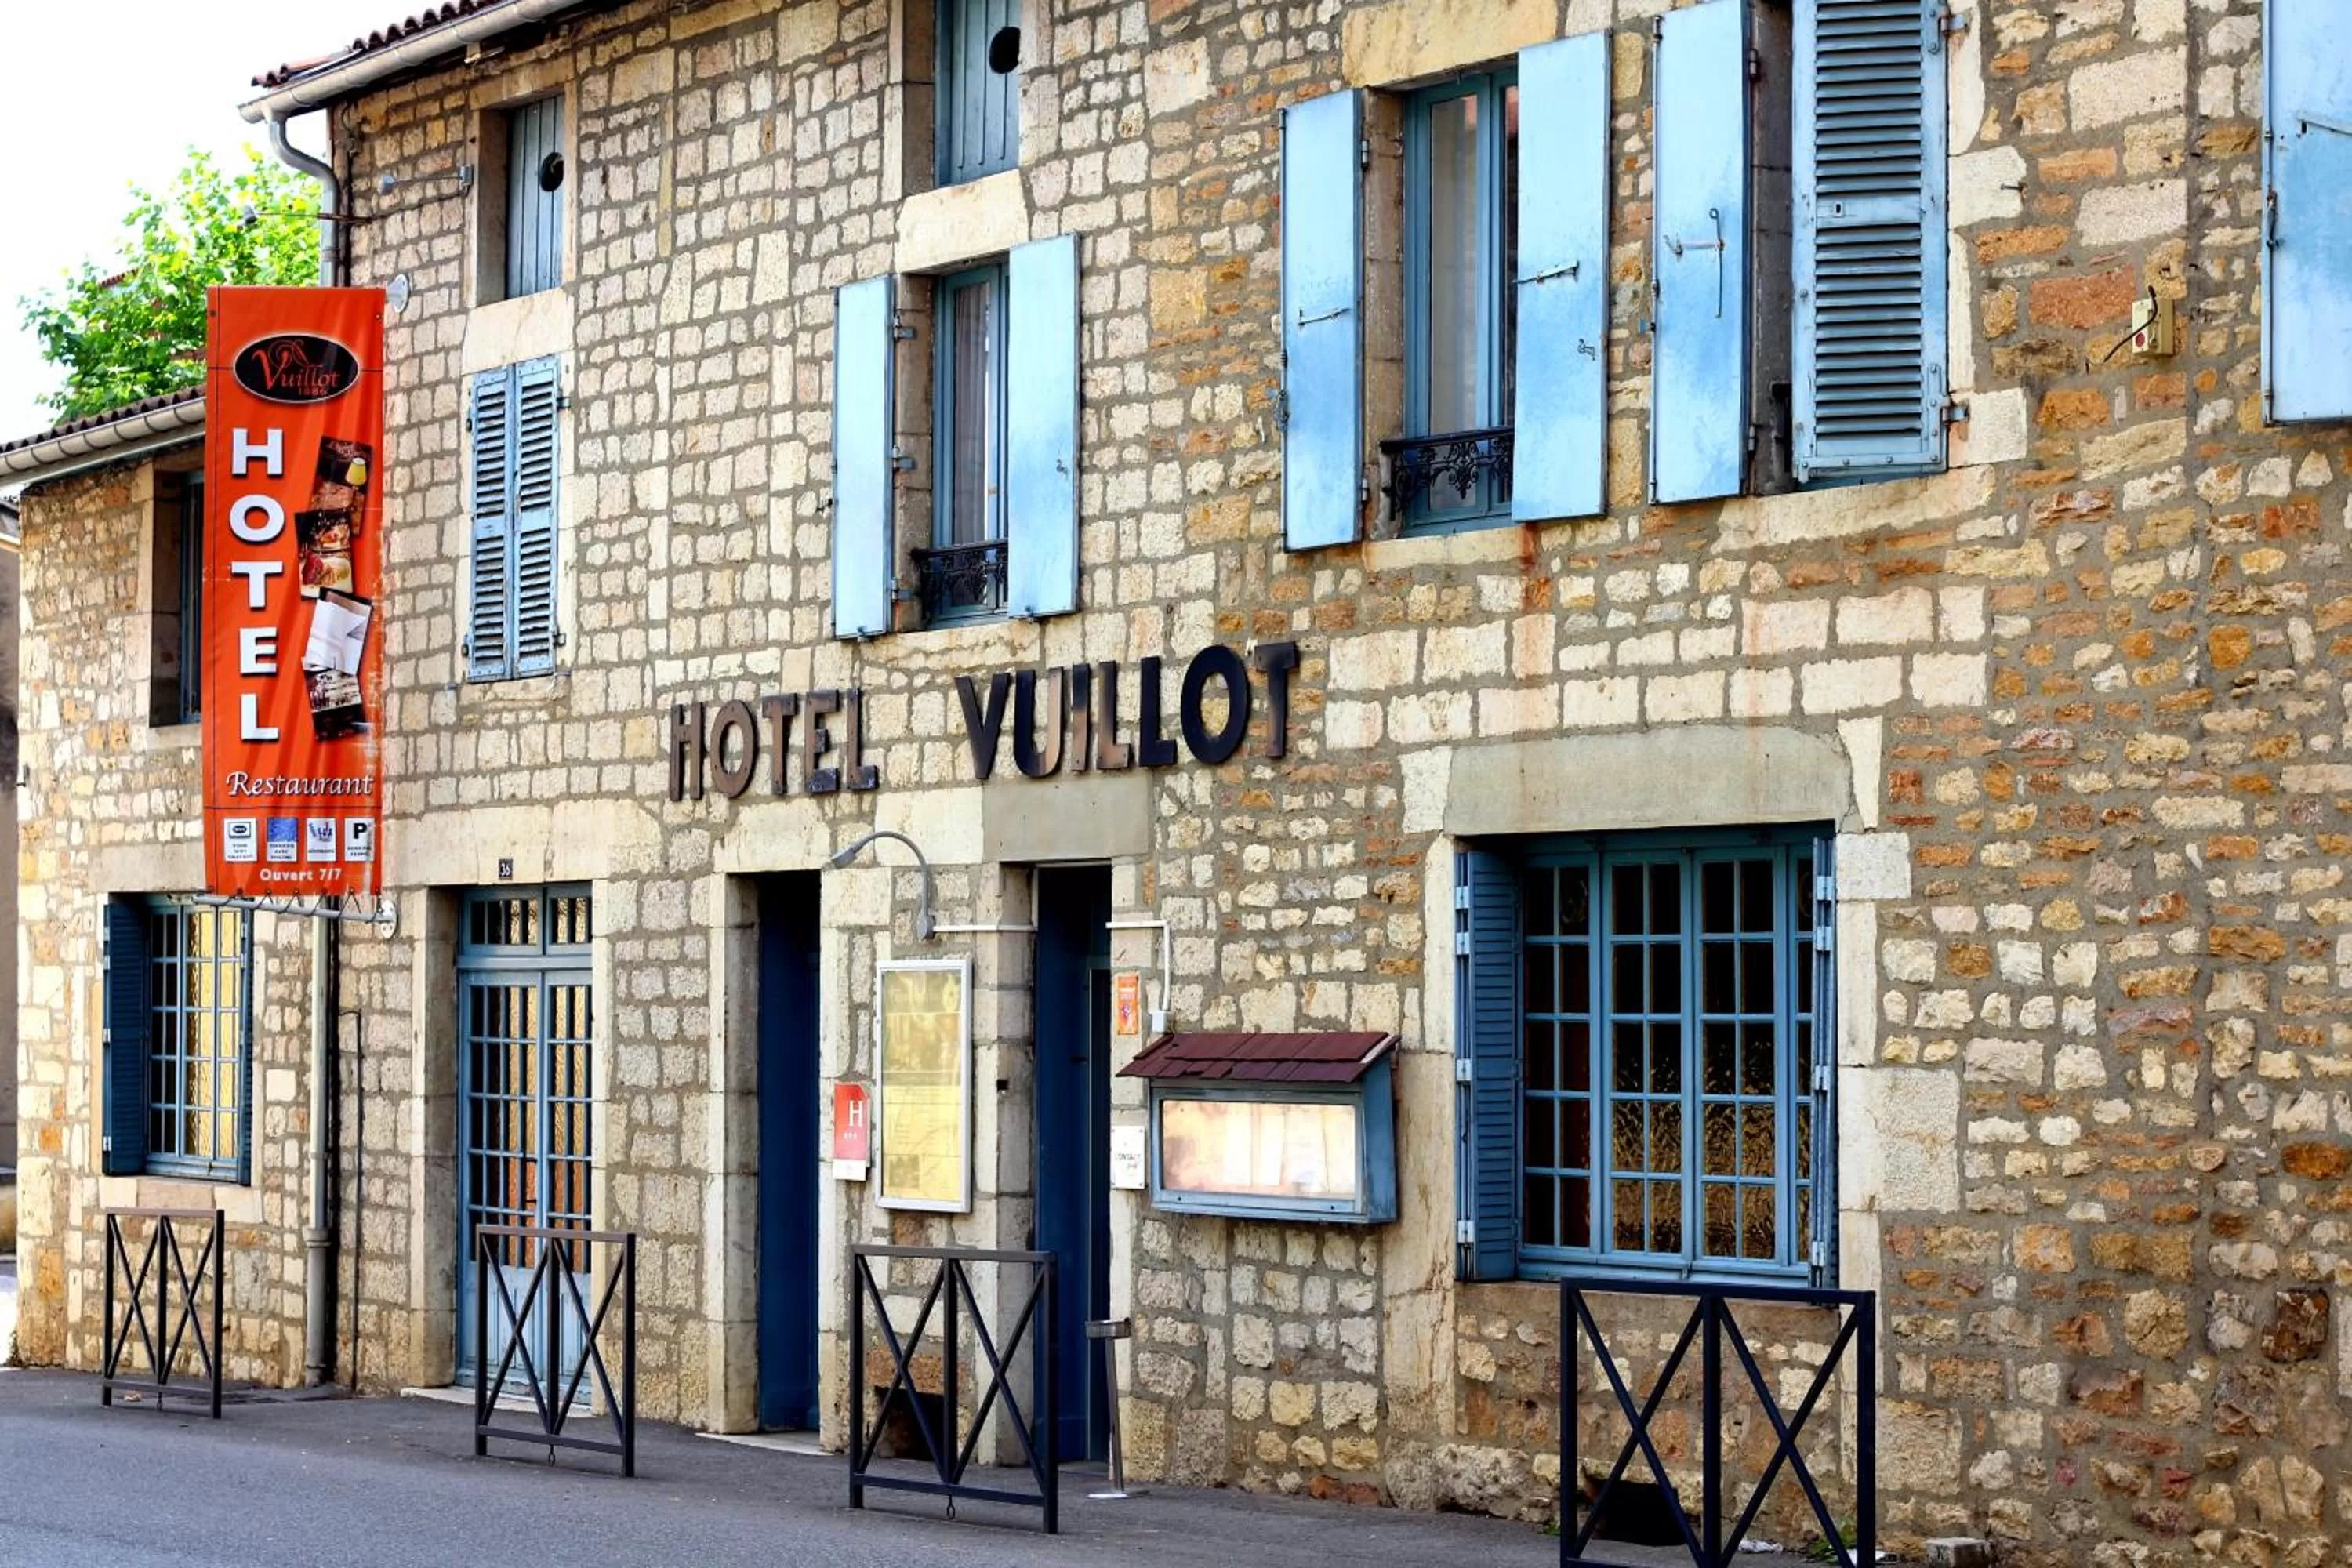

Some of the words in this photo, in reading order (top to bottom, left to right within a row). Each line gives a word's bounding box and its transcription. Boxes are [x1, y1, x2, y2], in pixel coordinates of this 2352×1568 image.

[252, 348, 339, 390] Vuillot
[669, 687, 880, 801] HOTEL
[954, 641, 1300, 780] VUILLOT
[226, 771, 374, 797] Restaurant
[353, 822, 368, 840] P
[260, 868, 313, 881] Ouvert
[319, 867, 342, 881] 7/7
[848, 1099, 864, 1128] H
